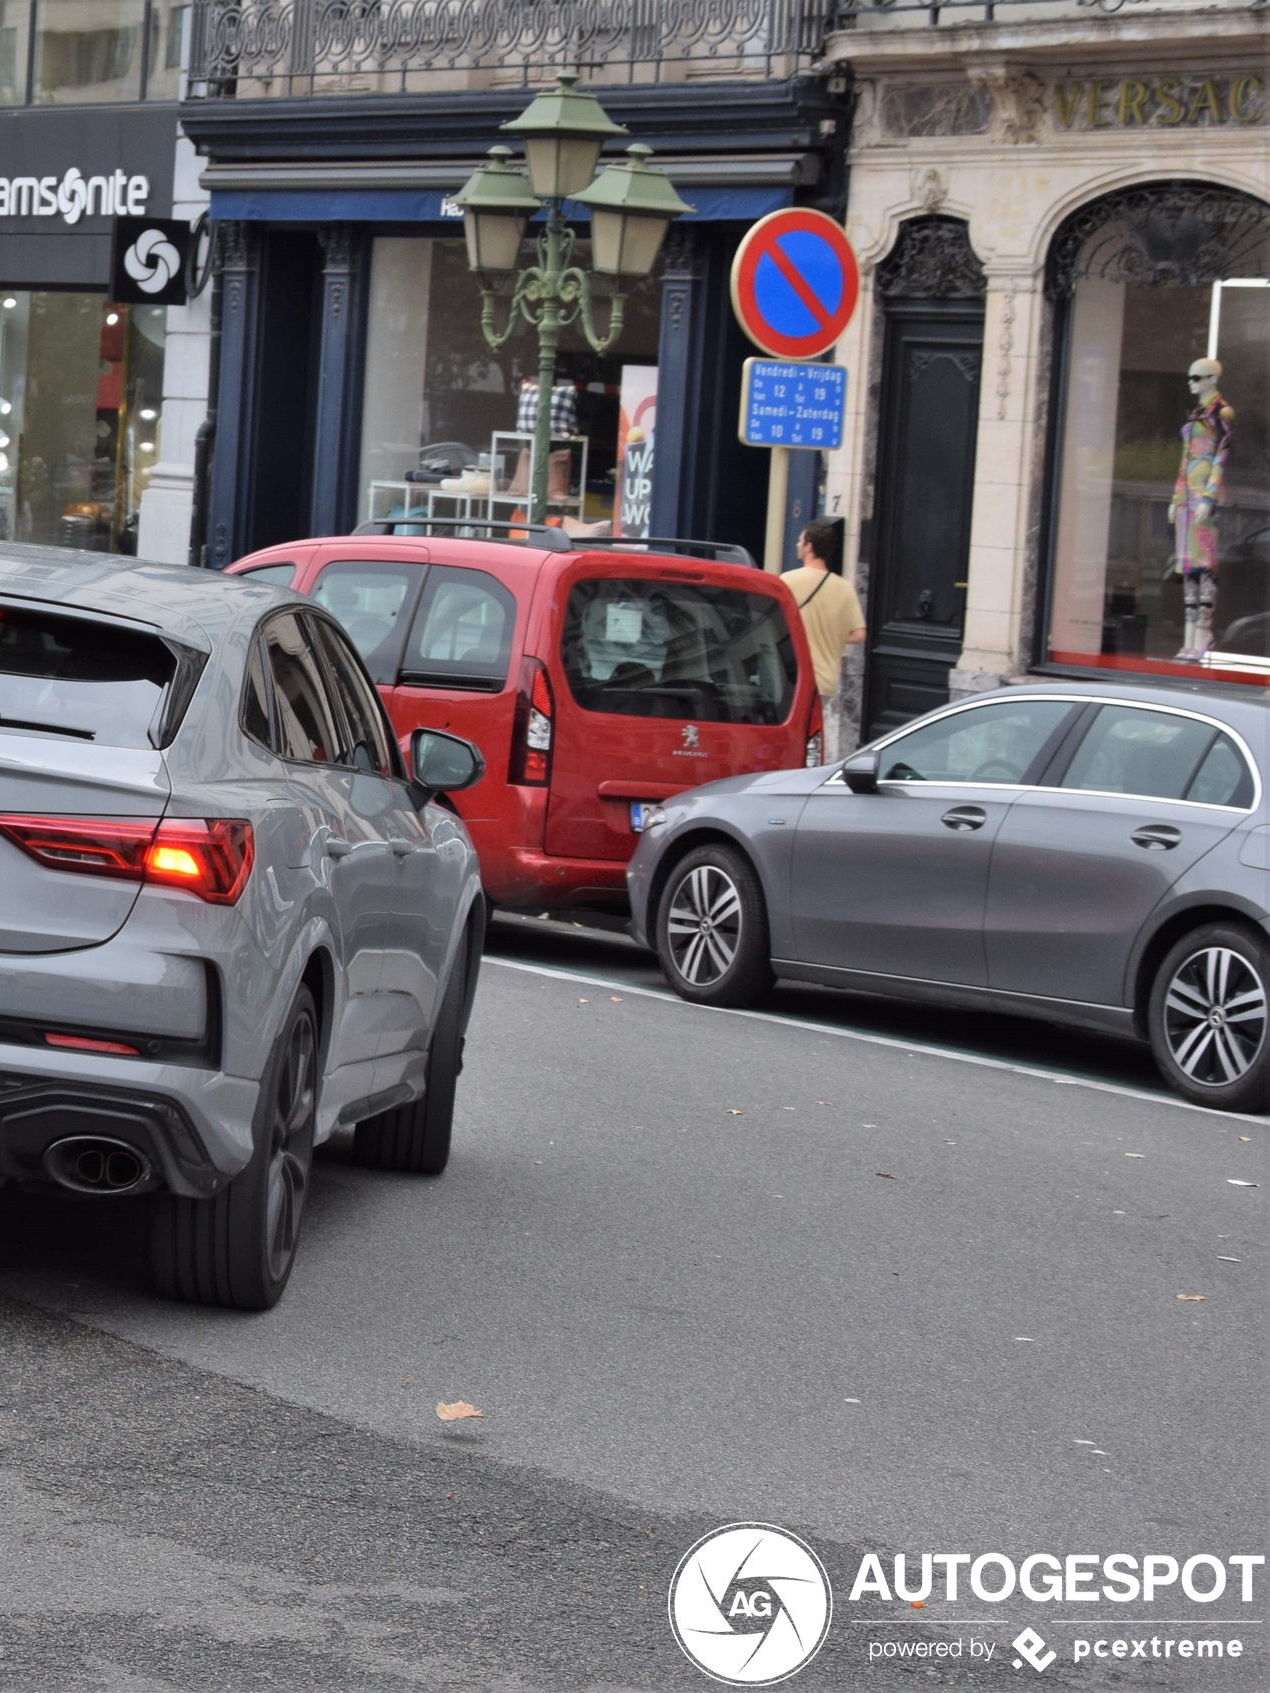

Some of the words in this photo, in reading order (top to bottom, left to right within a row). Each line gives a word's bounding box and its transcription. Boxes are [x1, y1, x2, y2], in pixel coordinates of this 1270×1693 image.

[1053, 75, 1266, 128] VERSAC
[754, 363, 798, 379] Vendredi
[807, 367, 842, 385] Vrijdag
[773, 384, 787, 398] 12
[814, 387, 827, 401] 19
[752, 402, 788, 418] Samedi
[795, 405, 840, 424] Zaterdag
[770, 424, 784, 438] 10
[811, 426, 824, 441] 19
[625, 478, 652, 500] UP
[832, 494, 843, 513] 7
[672, 750, 709, 758] PEUGEOT
